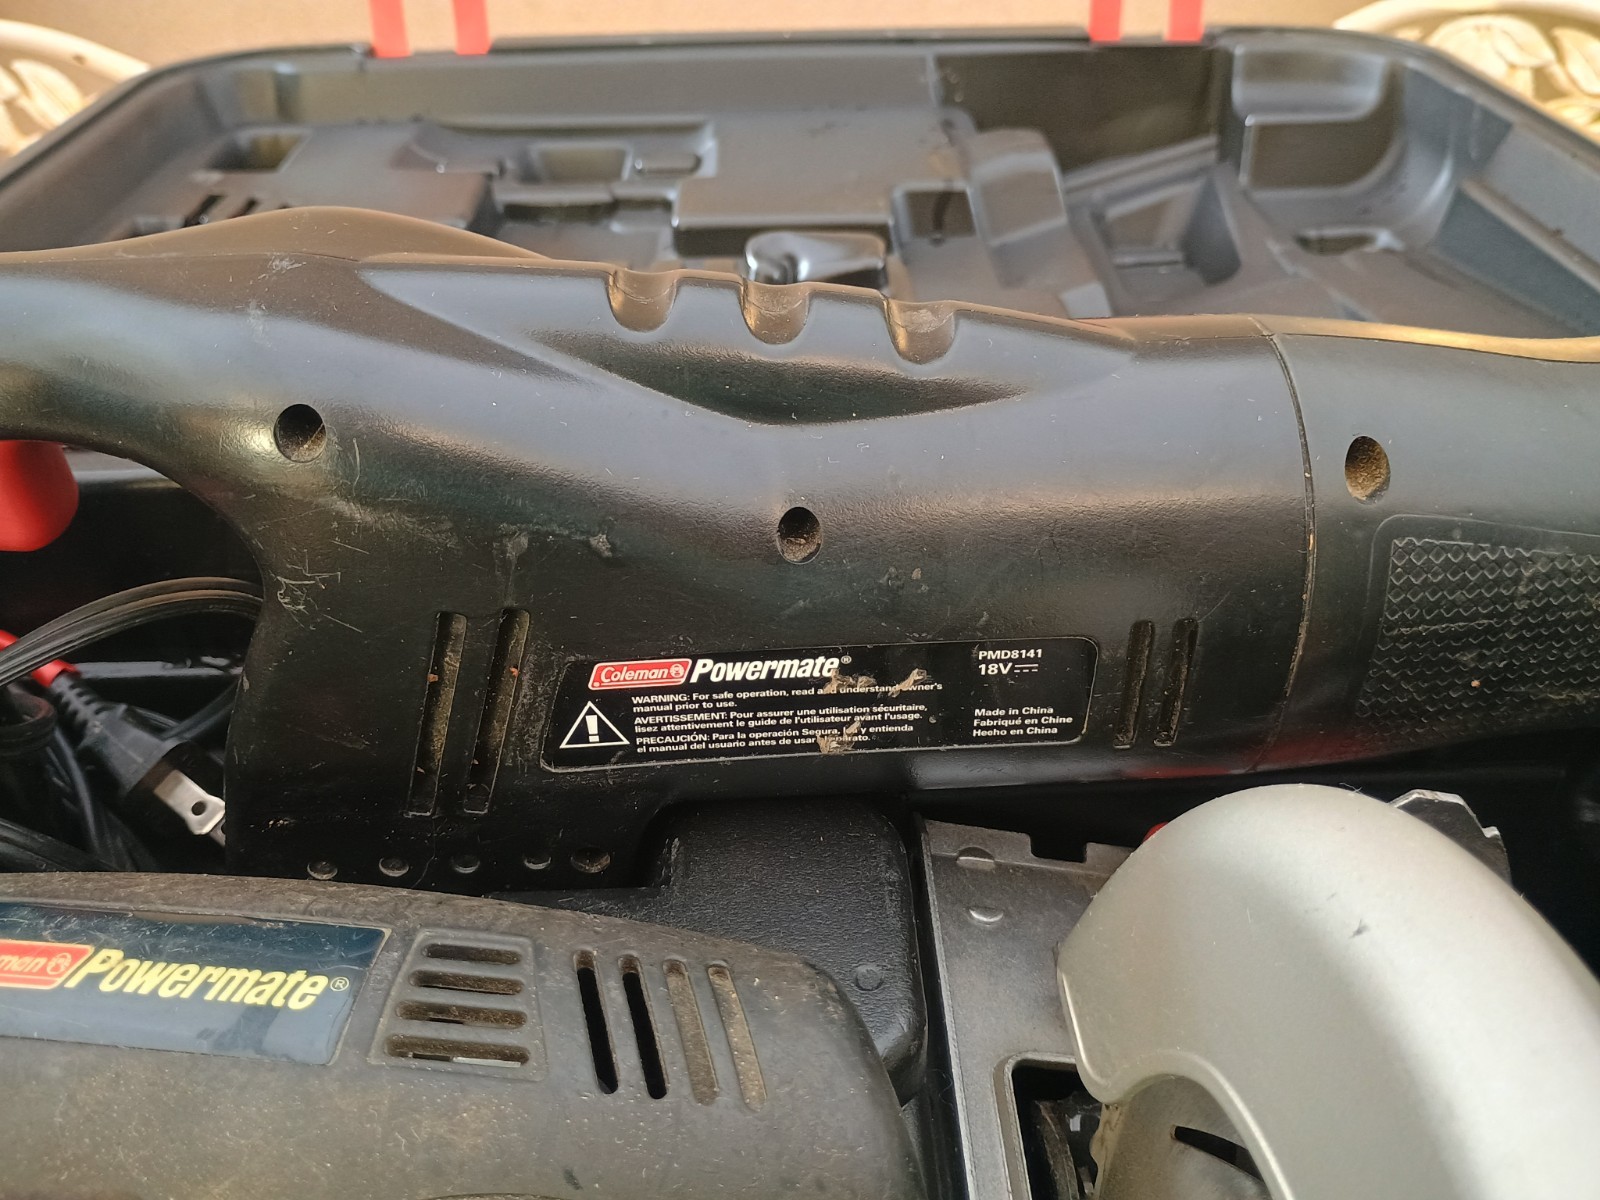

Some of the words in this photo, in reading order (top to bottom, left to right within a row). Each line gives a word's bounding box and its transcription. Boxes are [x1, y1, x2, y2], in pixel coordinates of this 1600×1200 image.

[978, 649, 1043, 660] PMD8141
[600, 666, 669, 683] Coleman
[631, 693, 691, 704] WARNING:
[692, 692, 710, 701] For
[712, 691, 734, 700] safe
[736, 689, 789, 699] operation,
[791, 687, 815, 696] read
[632, 703, 673, 713] manual
[675, 702, 700, 711] prior
[702, 701, 713, 709] to
[716, 700, 738, 708] use.
[634, 711, 728, 725] AVERTISSEMENT:
[729, 711, 755, 719] Pour
[756, 709, 795, 718] assurer
[796, 708, 817, 716] une
[818, 705, 870, 715] utilisation
[872, 703, 928, 713] sécuritaire,
[974, 708, 1006, 717] Made
[1008, 707, 1019, 715] in
[1021, 706, 1054, 715] China
[634, 725, 659, 733] lisez
[660, 719, 734, 732] attentivement
[736, 719, 746, 727] le
[748, 718, 777, 728] guide
[779, 717, 793, 725] de
[794, 714, 851, 724] l'utilisateur
[853, 713, 882, 722] avant
[884, 712, 923, 721] l'usage.
[973, 717, 1022, 727] Fabriqué
[1040, 715, 1074, 724] Chine
[636, 731, 710, 745] PRECAUCIÓN:
[712, 732, 735, 741] Para
[737, 731, 746, 739] la
[748, 728, 800, 740] operación
[801, 728, 840, 738] Segura,
[860, 727, 867, 735] y
[869, 724, 914, 733] entienda
[972, 728, 1007, 737] Hecho
[1009, 728, 1024, 736] en
[1026, 727, 1058, 735] China
[636, 745, 647, 753] el
[648, 743, 688, 752] manual
[689, 742, 706, 750] del
[708, 740, 746, 749] usuario
[748, 738, 777, 747] antes
[778, 737, 792, 745] de
[794, 736, 816, 745] usar
